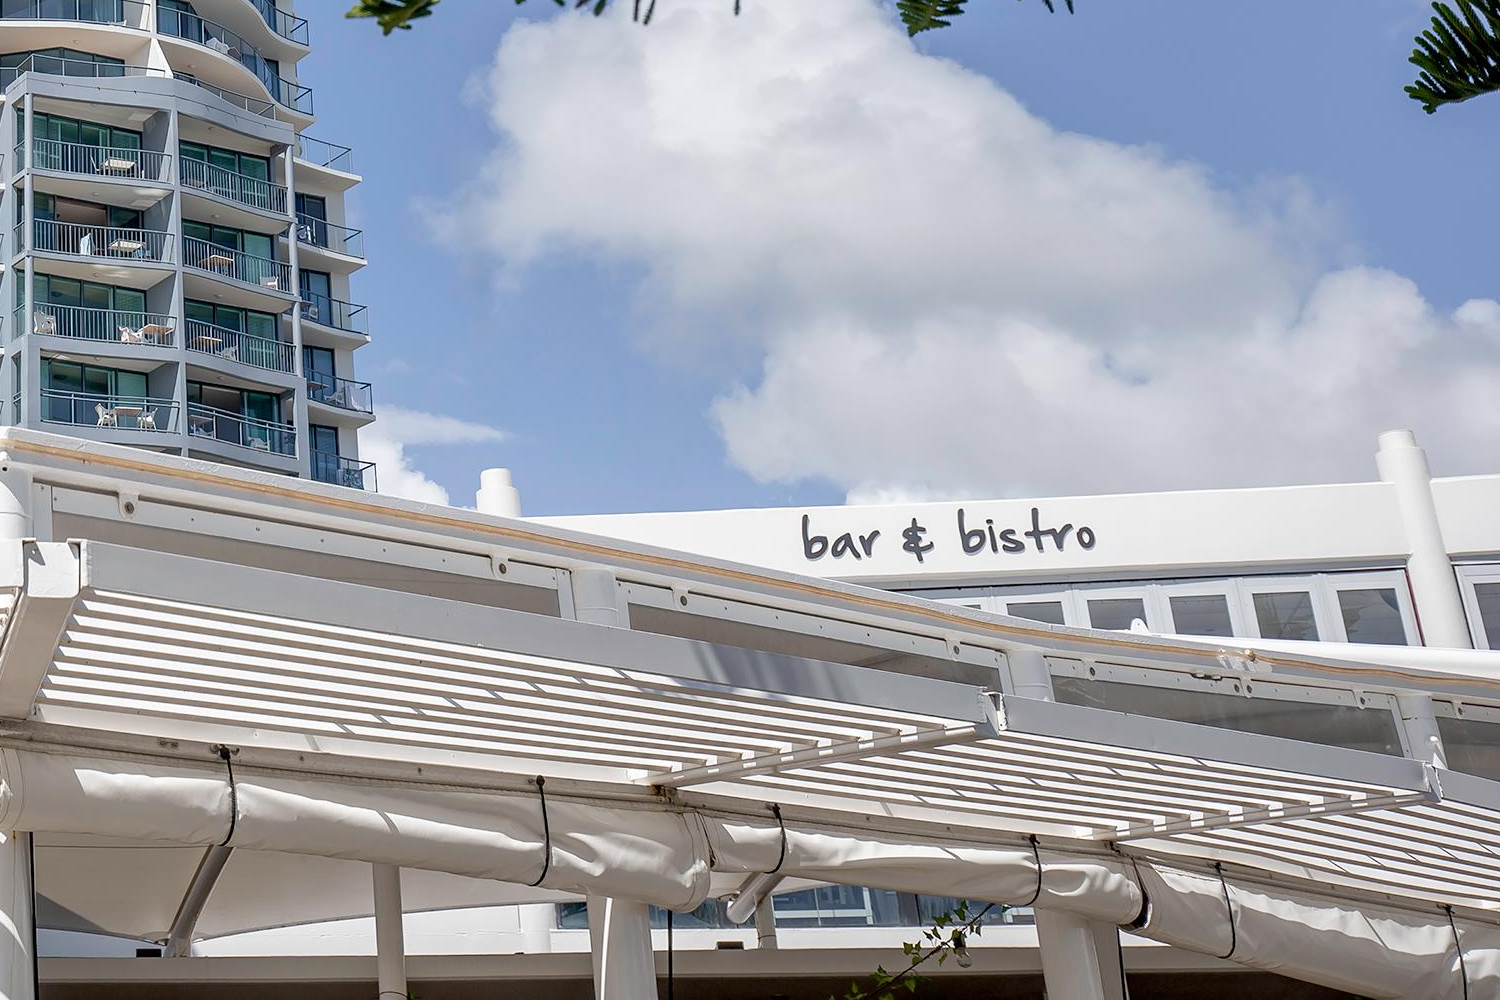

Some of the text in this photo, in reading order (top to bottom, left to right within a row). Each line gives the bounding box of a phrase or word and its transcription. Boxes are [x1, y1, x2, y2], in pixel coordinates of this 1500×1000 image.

[801, 507, 1097, 563] bar & bistro
